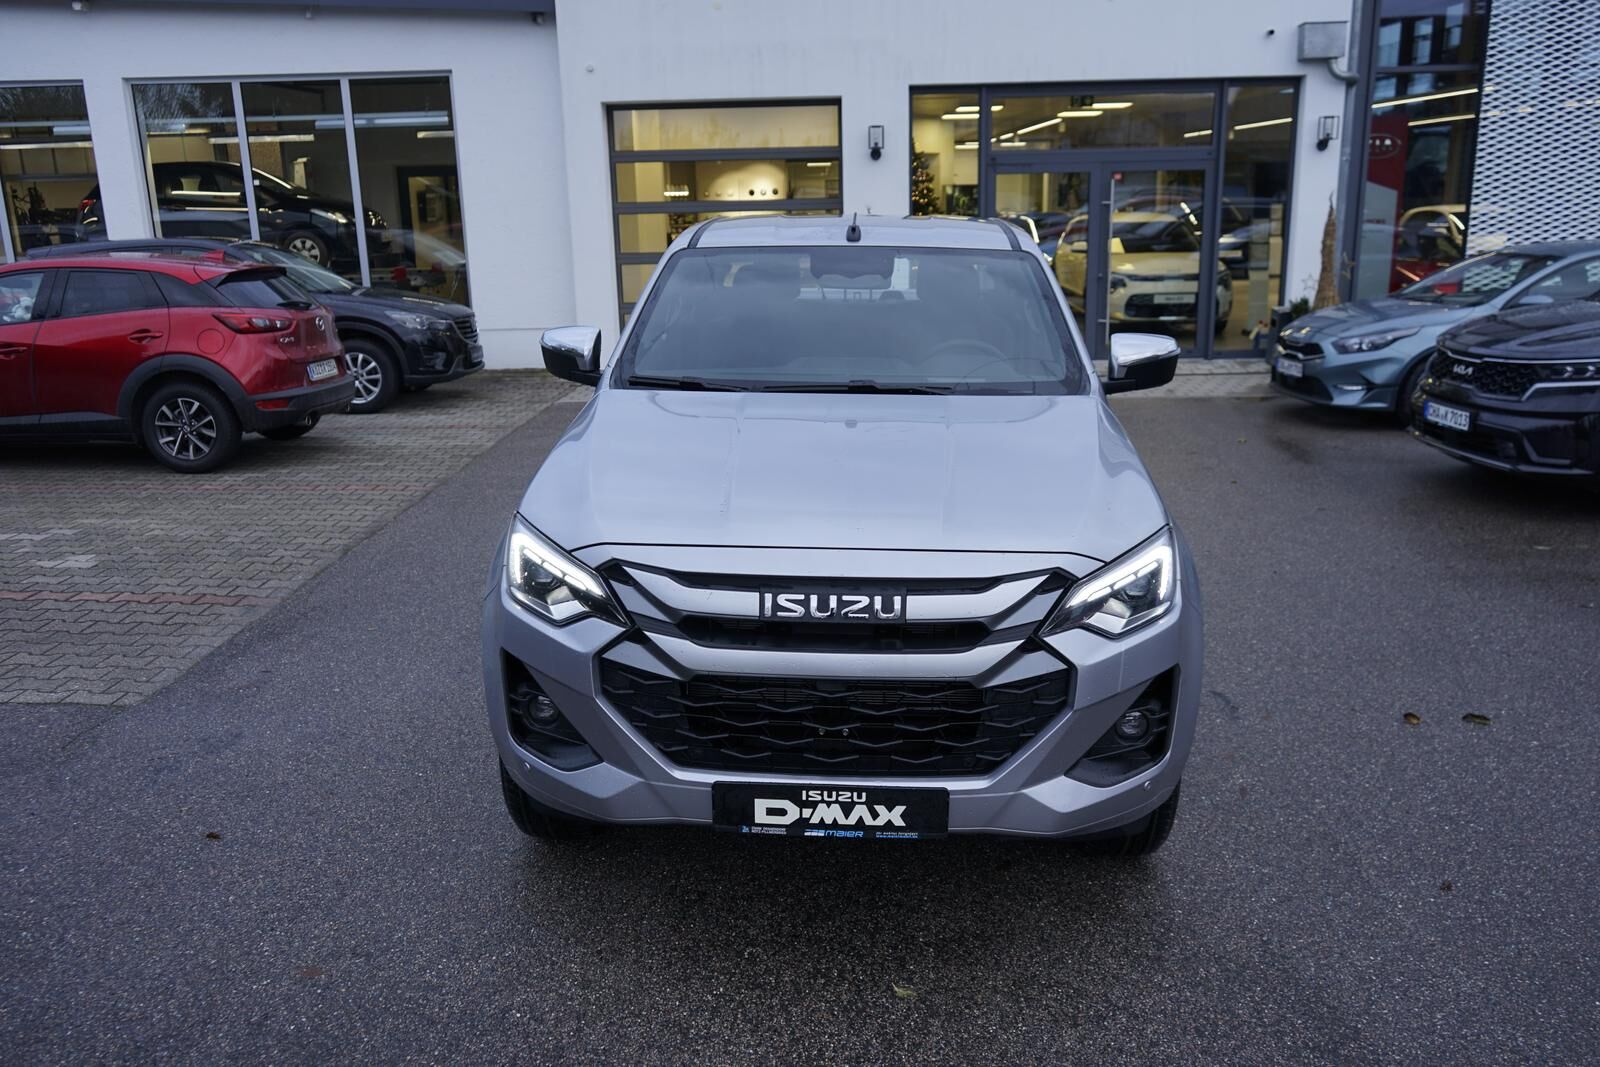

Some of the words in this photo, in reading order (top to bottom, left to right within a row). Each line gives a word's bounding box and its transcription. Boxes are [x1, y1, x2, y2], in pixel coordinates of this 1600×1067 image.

[1450, 410, 1469, 427] 7013
[764, 592, 902, 619] ISUZU
[802, 790, 866, 802] ISUZU
[754, 798, 907, 827] D-MAX
